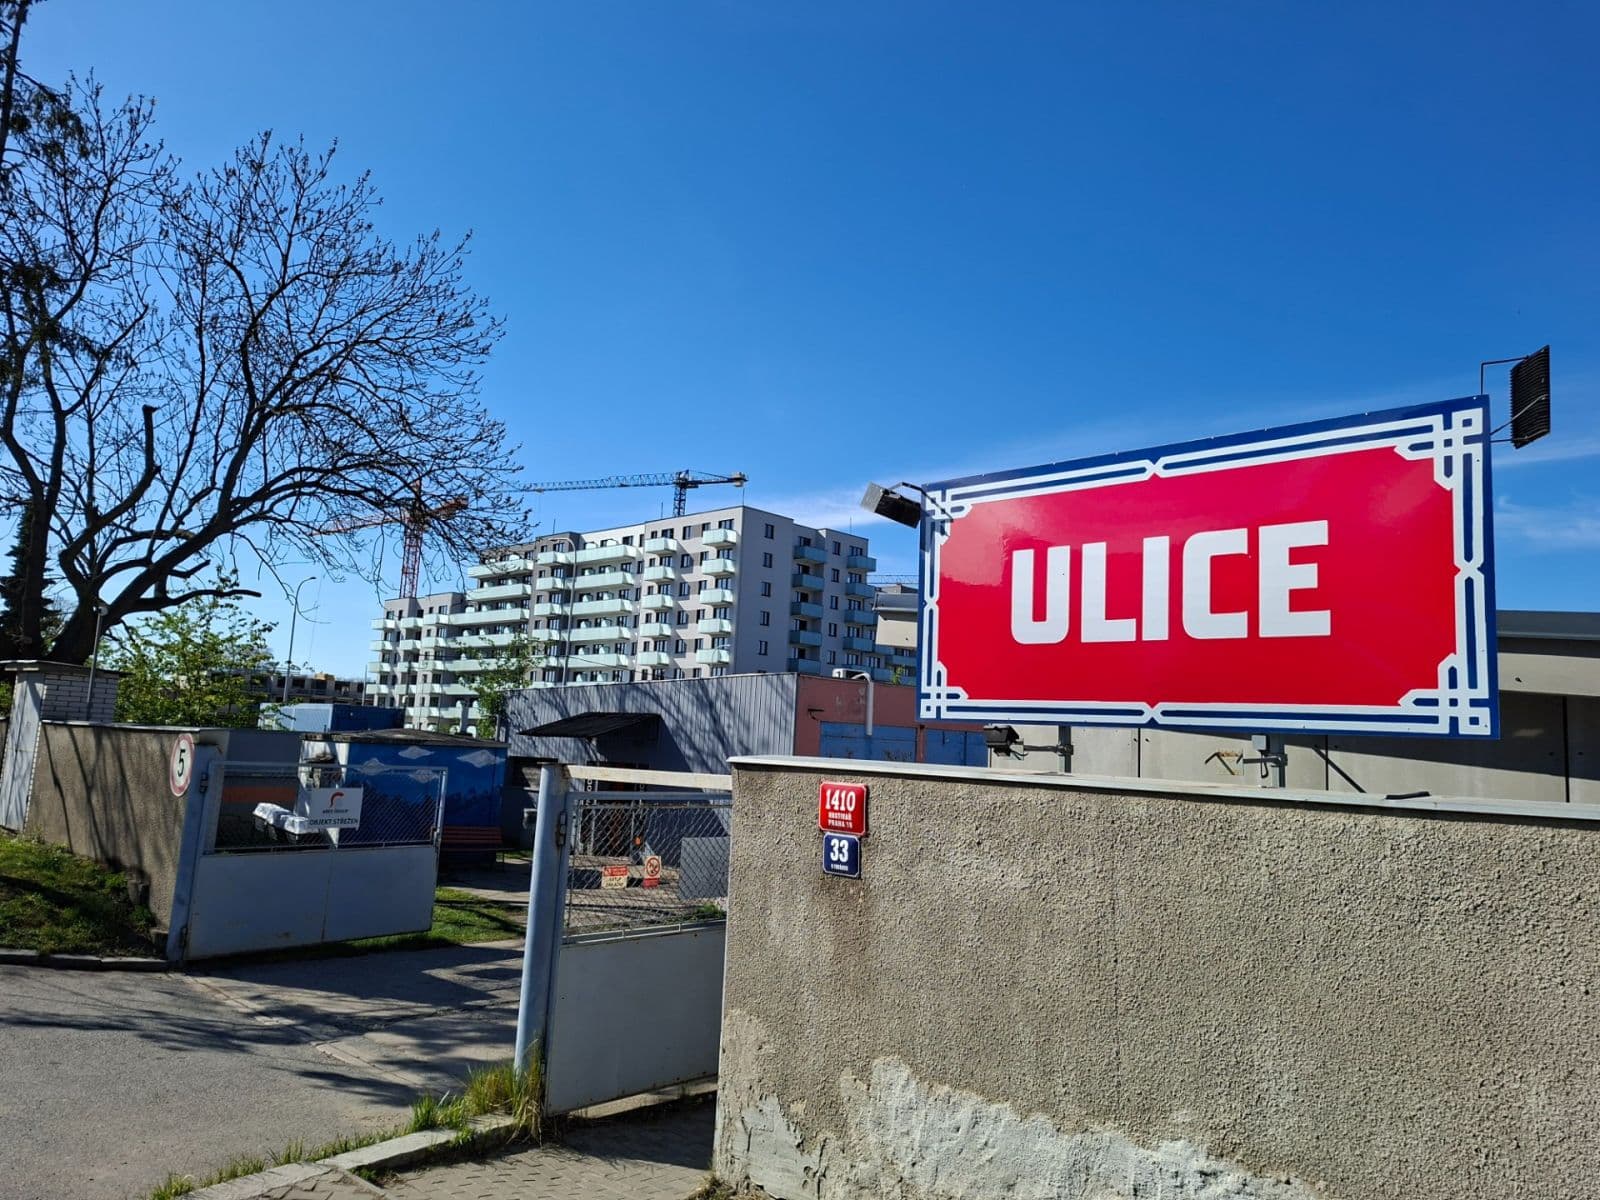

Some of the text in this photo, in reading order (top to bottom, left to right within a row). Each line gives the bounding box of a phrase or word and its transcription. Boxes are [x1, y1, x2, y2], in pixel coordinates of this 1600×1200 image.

[1010, 519, 1332, 645] ULICE
[177, 748, 186, 778] 5
[825, 789, 856, 811] 1410
[830, 838, 849, 862] 33
